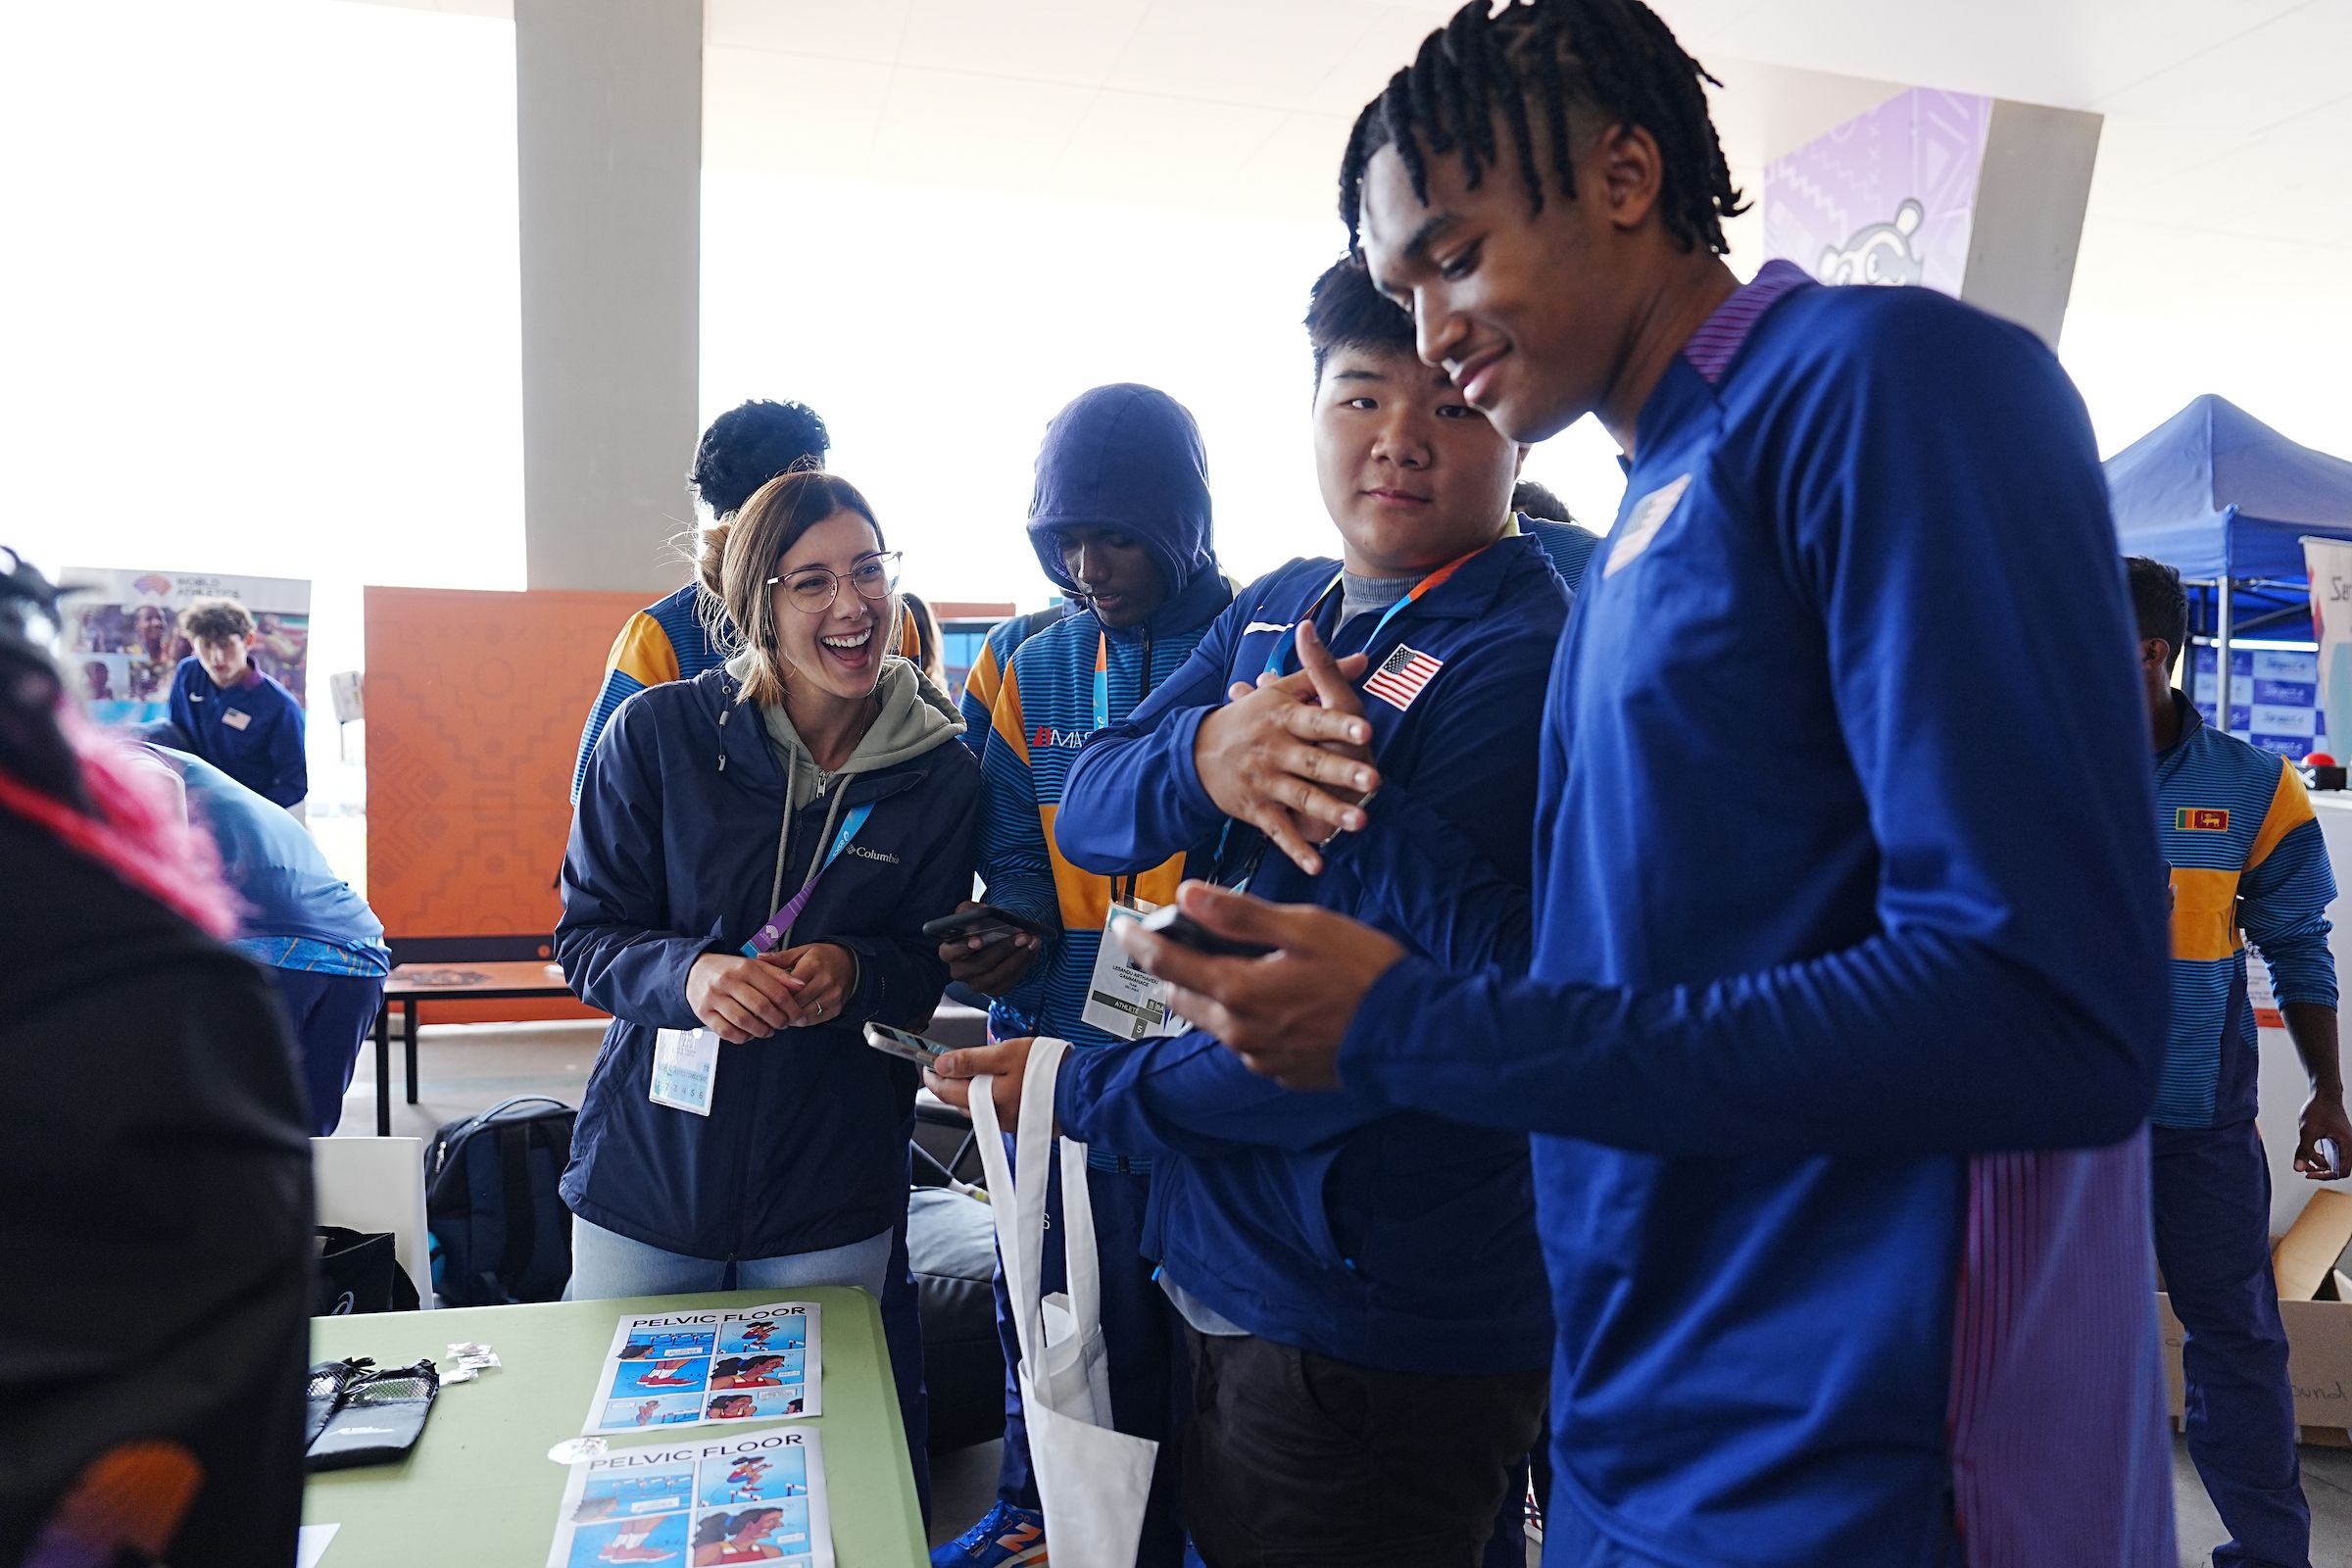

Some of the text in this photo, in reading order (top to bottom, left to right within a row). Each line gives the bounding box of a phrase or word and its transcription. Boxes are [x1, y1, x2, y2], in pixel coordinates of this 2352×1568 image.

[856, 846, 901, 864] Columbia
[632, 1306, 806, 1328] PELVIC FLOOR
[589, 1434, 803, 1470] PELVIC FLOOR
